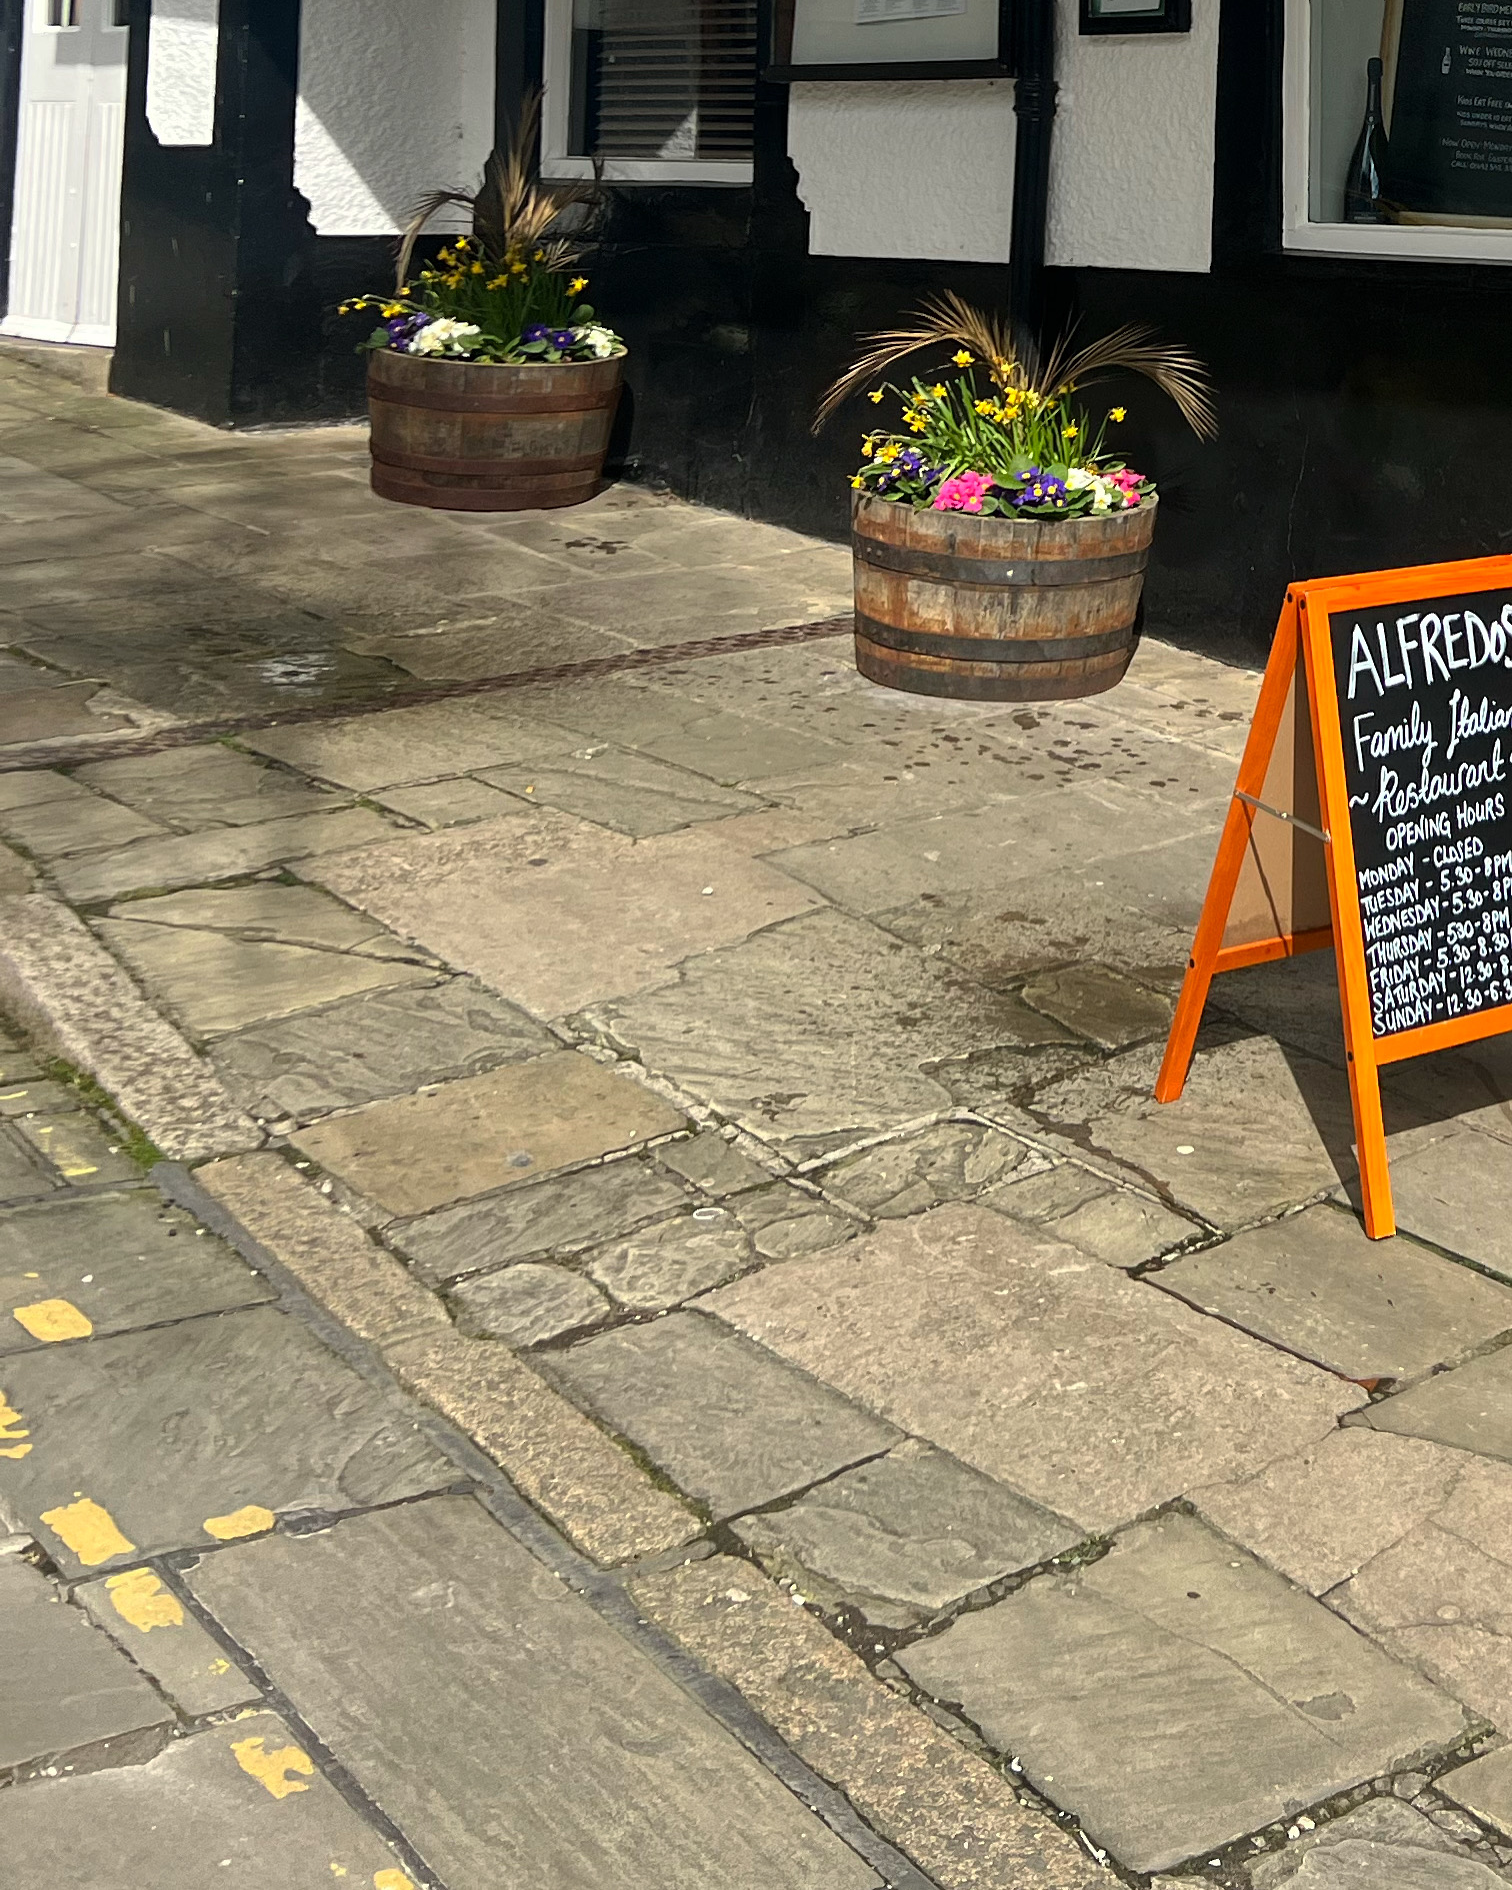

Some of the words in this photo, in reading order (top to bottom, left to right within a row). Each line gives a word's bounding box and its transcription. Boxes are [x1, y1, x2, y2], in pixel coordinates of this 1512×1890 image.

[1459, 45, 1481, 56] WINE
[1473, 96, 1487, 107] EAT
[1487, 97, 1503, 109] FREE
[1353, 700, 1438, 772] Family
[1371, 738, 1506, 823] Restaurant
[1386, 811, 1451, 851] OPENING
[1456, 792, 1505, 829] HOURS
[1359, 851, 1415, 890] MONDAY
[1433, 835, 1484, 868] CLOSED
[1361, 878, 1419, 916] TUESDAY
[1363, 895, 1440, 941] WEDNESDAY
[1366, 927, 1432, 968] THURSDAY
[1369, 956, 1419, 992] FRIDAY
[1372, 969, 1446, 1014] SATURDAY
[1372, 998, 1433, 1035] SUNDAY
